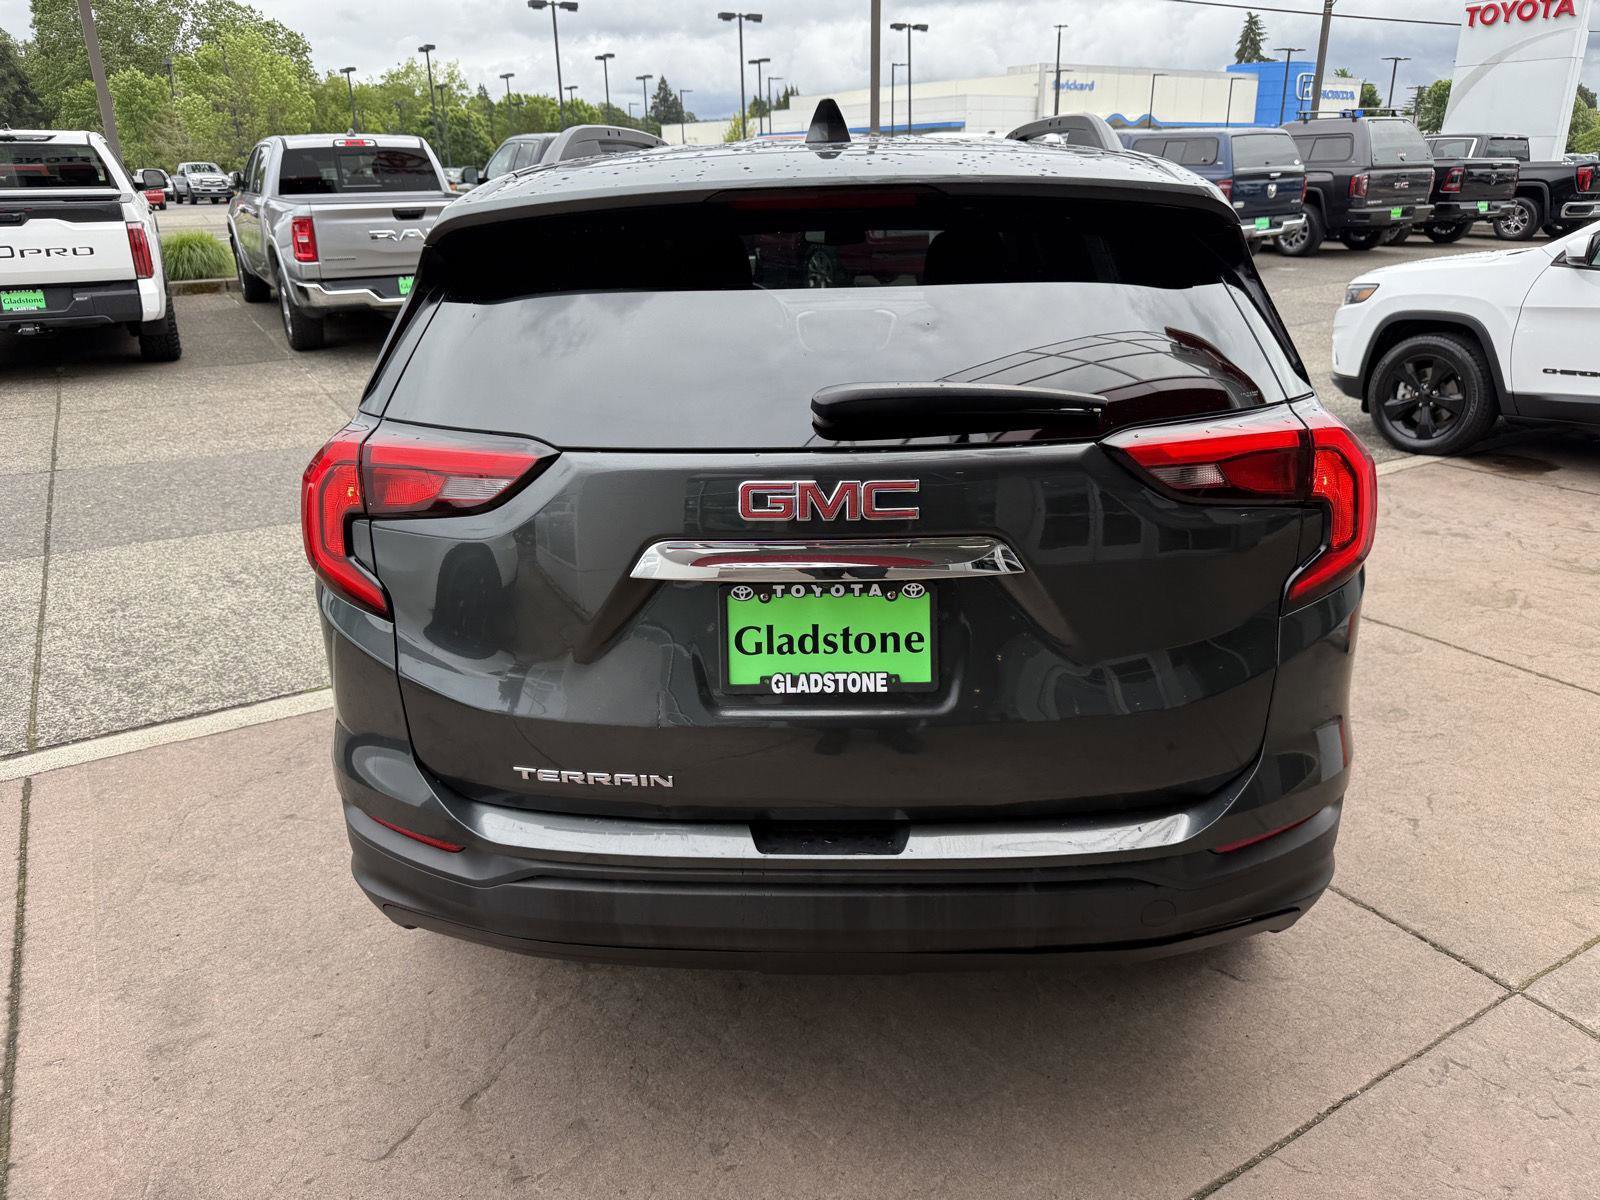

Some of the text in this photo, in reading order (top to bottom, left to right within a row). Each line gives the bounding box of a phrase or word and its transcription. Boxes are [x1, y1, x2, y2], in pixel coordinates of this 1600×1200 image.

[1466, 0, 1576, 28] TOYOTA
[738, 480, 919, 521] GMC
[772, 583, 883, 598] TOYOTA
[734, 624, 925, 655] Gladstone
[771, 672, 888, 694] GLADSTONE
[513, 766, 674, 788] TERRAIN
